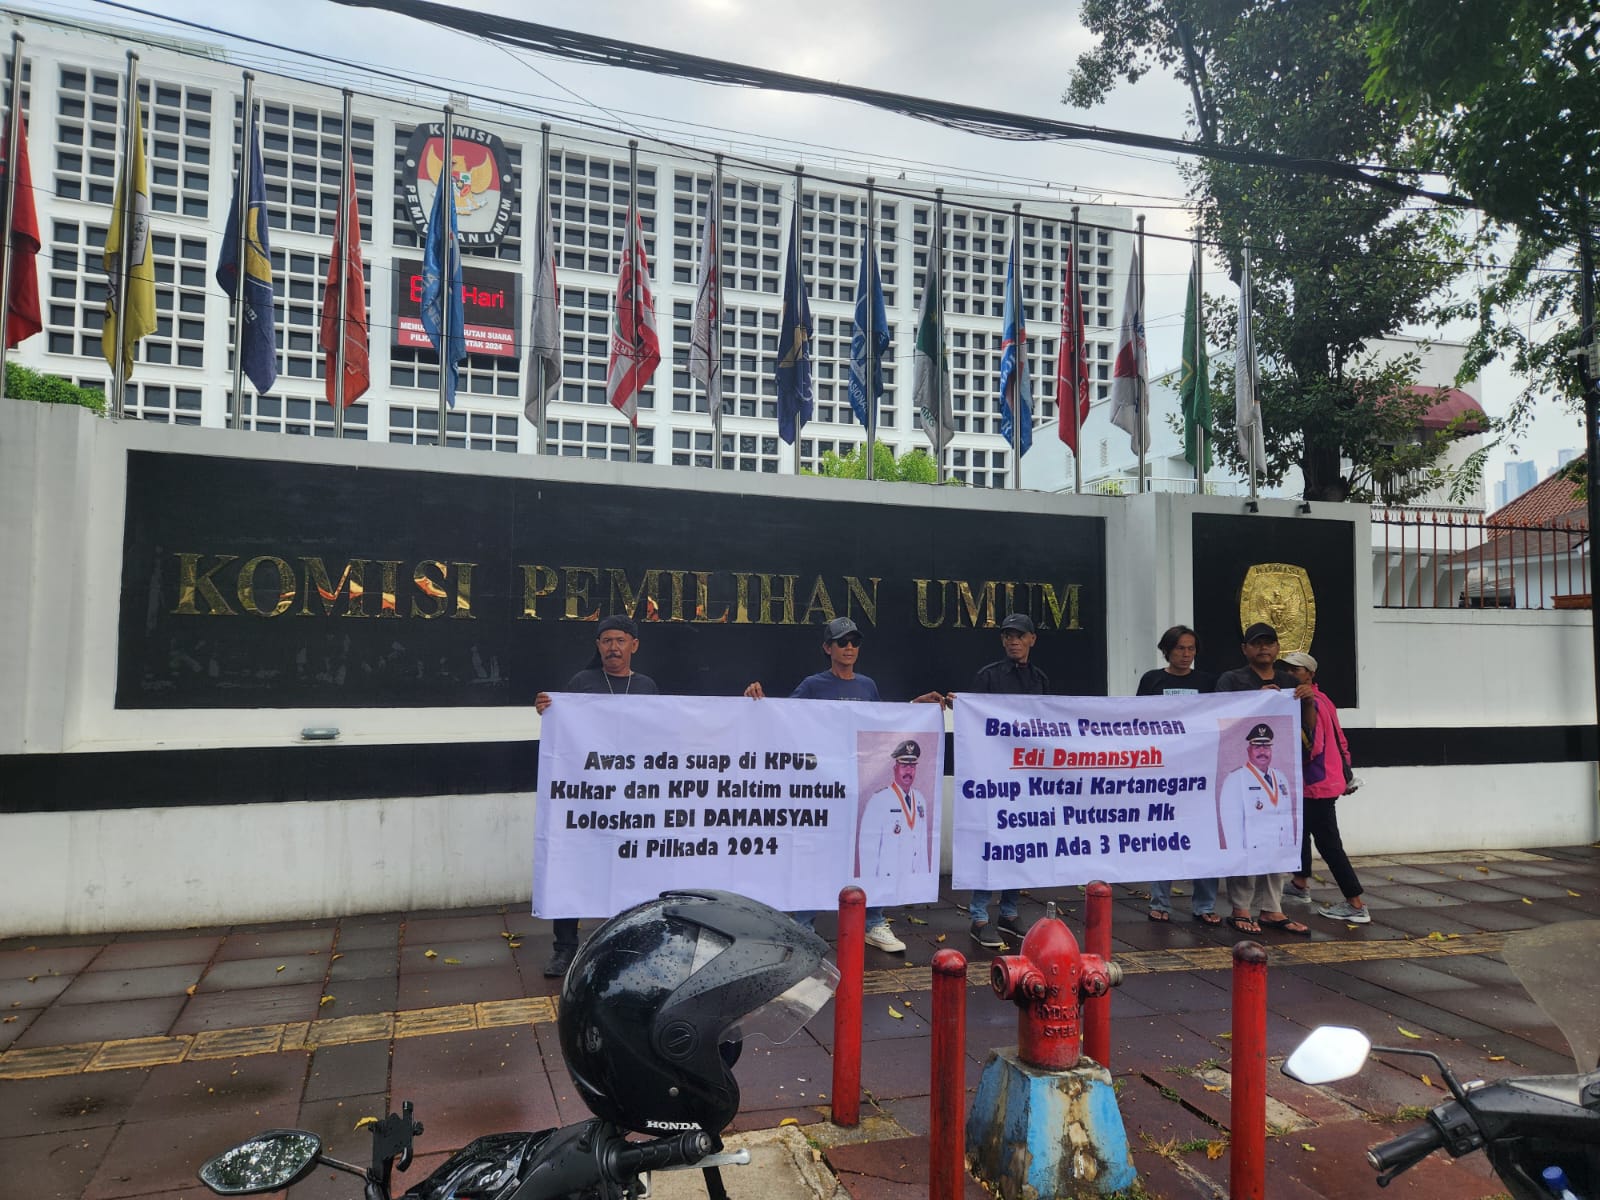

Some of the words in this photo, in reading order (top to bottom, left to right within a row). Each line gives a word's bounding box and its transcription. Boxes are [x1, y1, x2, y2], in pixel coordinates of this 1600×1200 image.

[461, 285, 505, 309] Hari
[170, 553, 478, 619] KOMISI
[516, 564, 882, 628] PEMILIHAN
[911, 578, 1084, 631] UMUM
[985, 718, 1072, 737] Batalkan
[1078, 718, 1186, 737] Pencalonan
[583, 751, 636, 771] Awas
[643, 751, 678, 770] ada
[685, 754, 731, 773] suap
[738, 751, 757, 770] di
[764, 751, 818, 771] KPUD
[1013, 747, 1045, 767] Edi
[1053, 746, 1163, 769] Damansyah
[550, 780, 617, 800] Kukar
[623, 780, 660, 800] dan
[668, 779, 709, 799] KPU
[716, 779, 782, 799] Kaltim
[789, 780, 847, 799] untuk
[962, 778, 1021, 802] Cabup
[1028, 777, 1083, 797] Kutai
[1090, 776, 1207, 797] Kartanegara
[566, 809, 656, 830] Loloskan
[663, 809, 696, 828] EDI
[703, 808, 829, 828] DAMANSYAH
[996, 806, 1056, 829] Sesuai
[1062, 805, 1141, 826] Putusan
[1147, 803, 1176, 822] Mk
[617, 839, 639, 859] di
[646, 837, 719, 858] Pilkada
[727, 836, 779, 856] 2024
[981, 841, 1049, 864] Jangan
[1054, 836, 1092, 858] Ada
[1099, 834, 1111, 855] 3
[1118, 831, 1192, 854] Periode
[646, 1120, 703, 1131] HONDA
